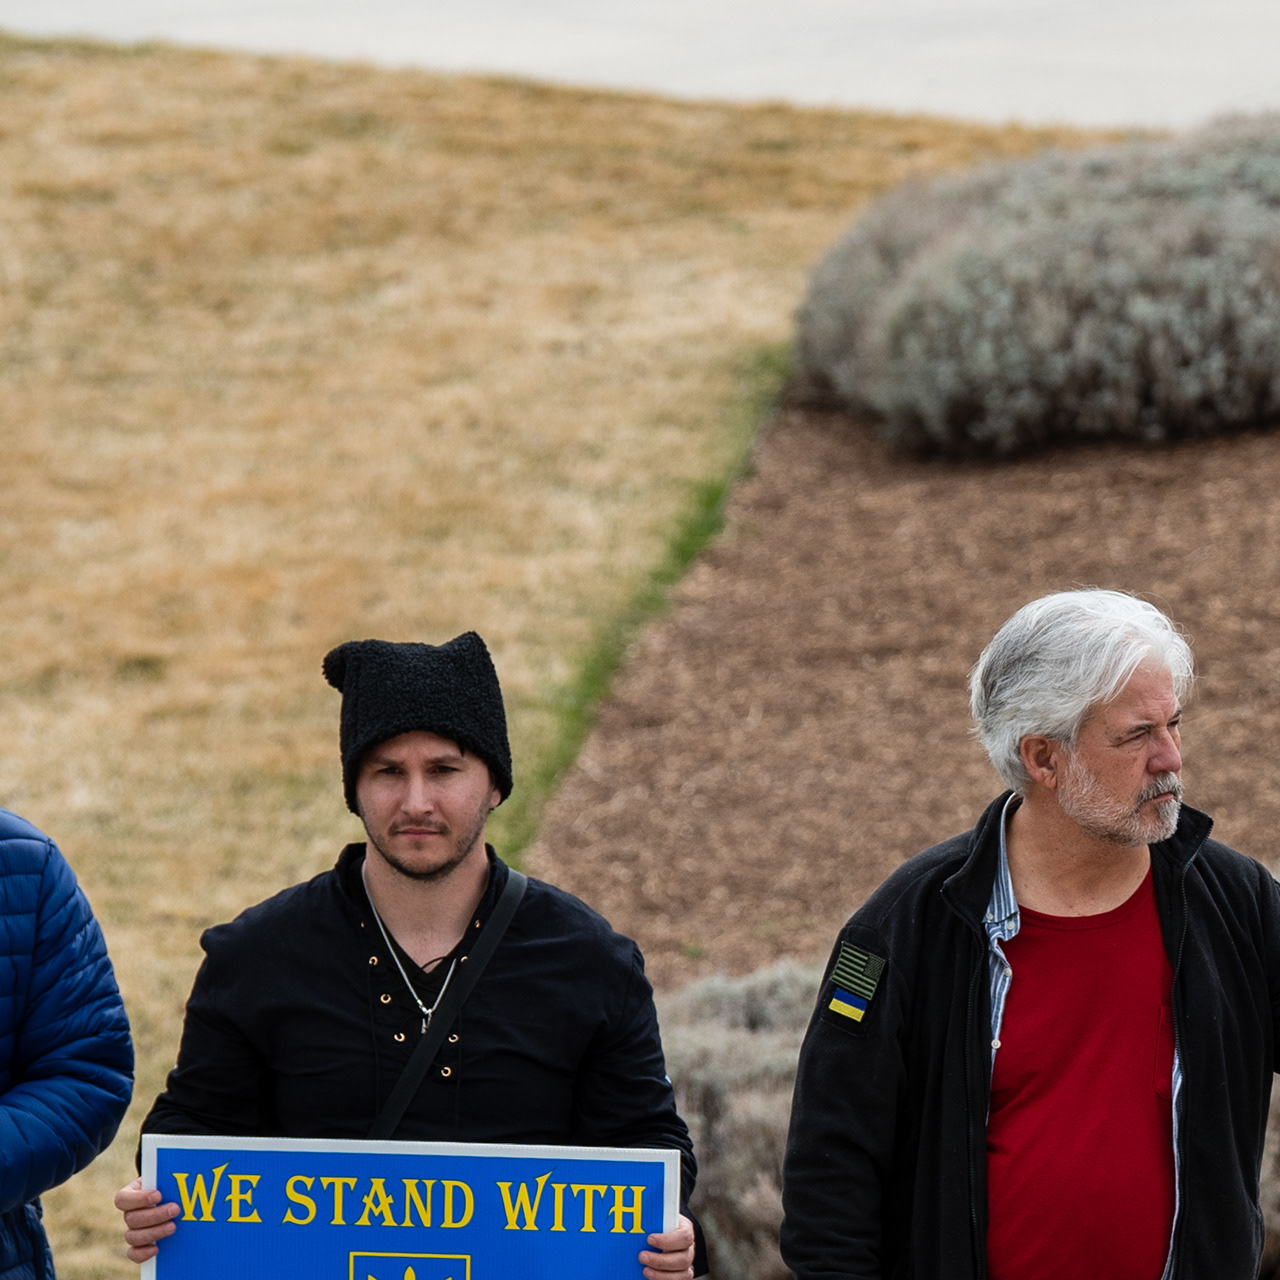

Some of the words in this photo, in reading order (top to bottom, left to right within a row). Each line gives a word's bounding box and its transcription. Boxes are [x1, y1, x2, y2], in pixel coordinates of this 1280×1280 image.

[172, 1162, 262, 1223] WE
[282, 1175, 475, 1229] STAND
[497, 1170, 646, 1234] WITH
